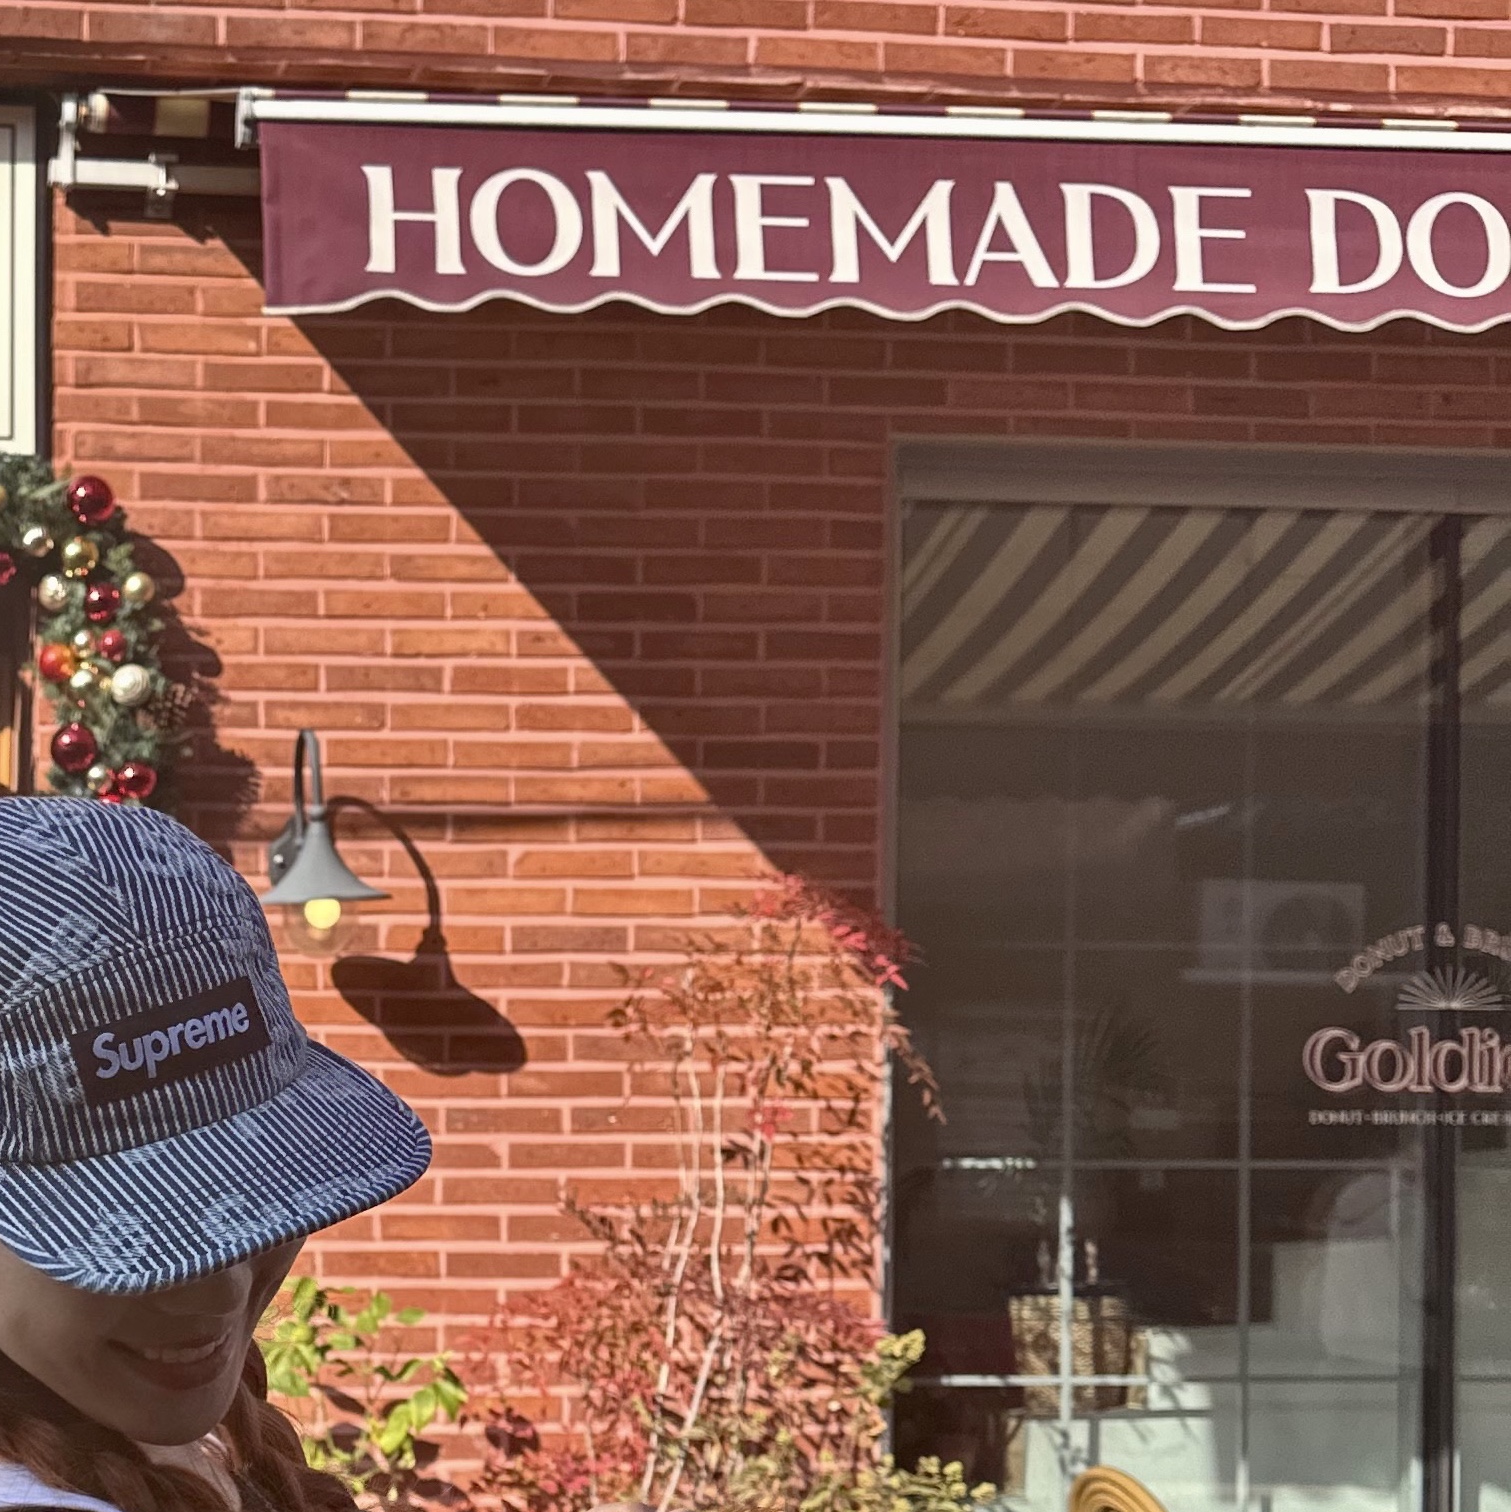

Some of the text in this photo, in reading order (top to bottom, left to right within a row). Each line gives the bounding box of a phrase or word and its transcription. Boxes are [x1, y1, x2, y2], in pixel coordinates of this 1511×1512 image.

[361, 164, 1511, 298] HOMEMADE DO
[1334, 924, 1425, 994] DONUT
[92, 1002, 250, 1079] Supreme
